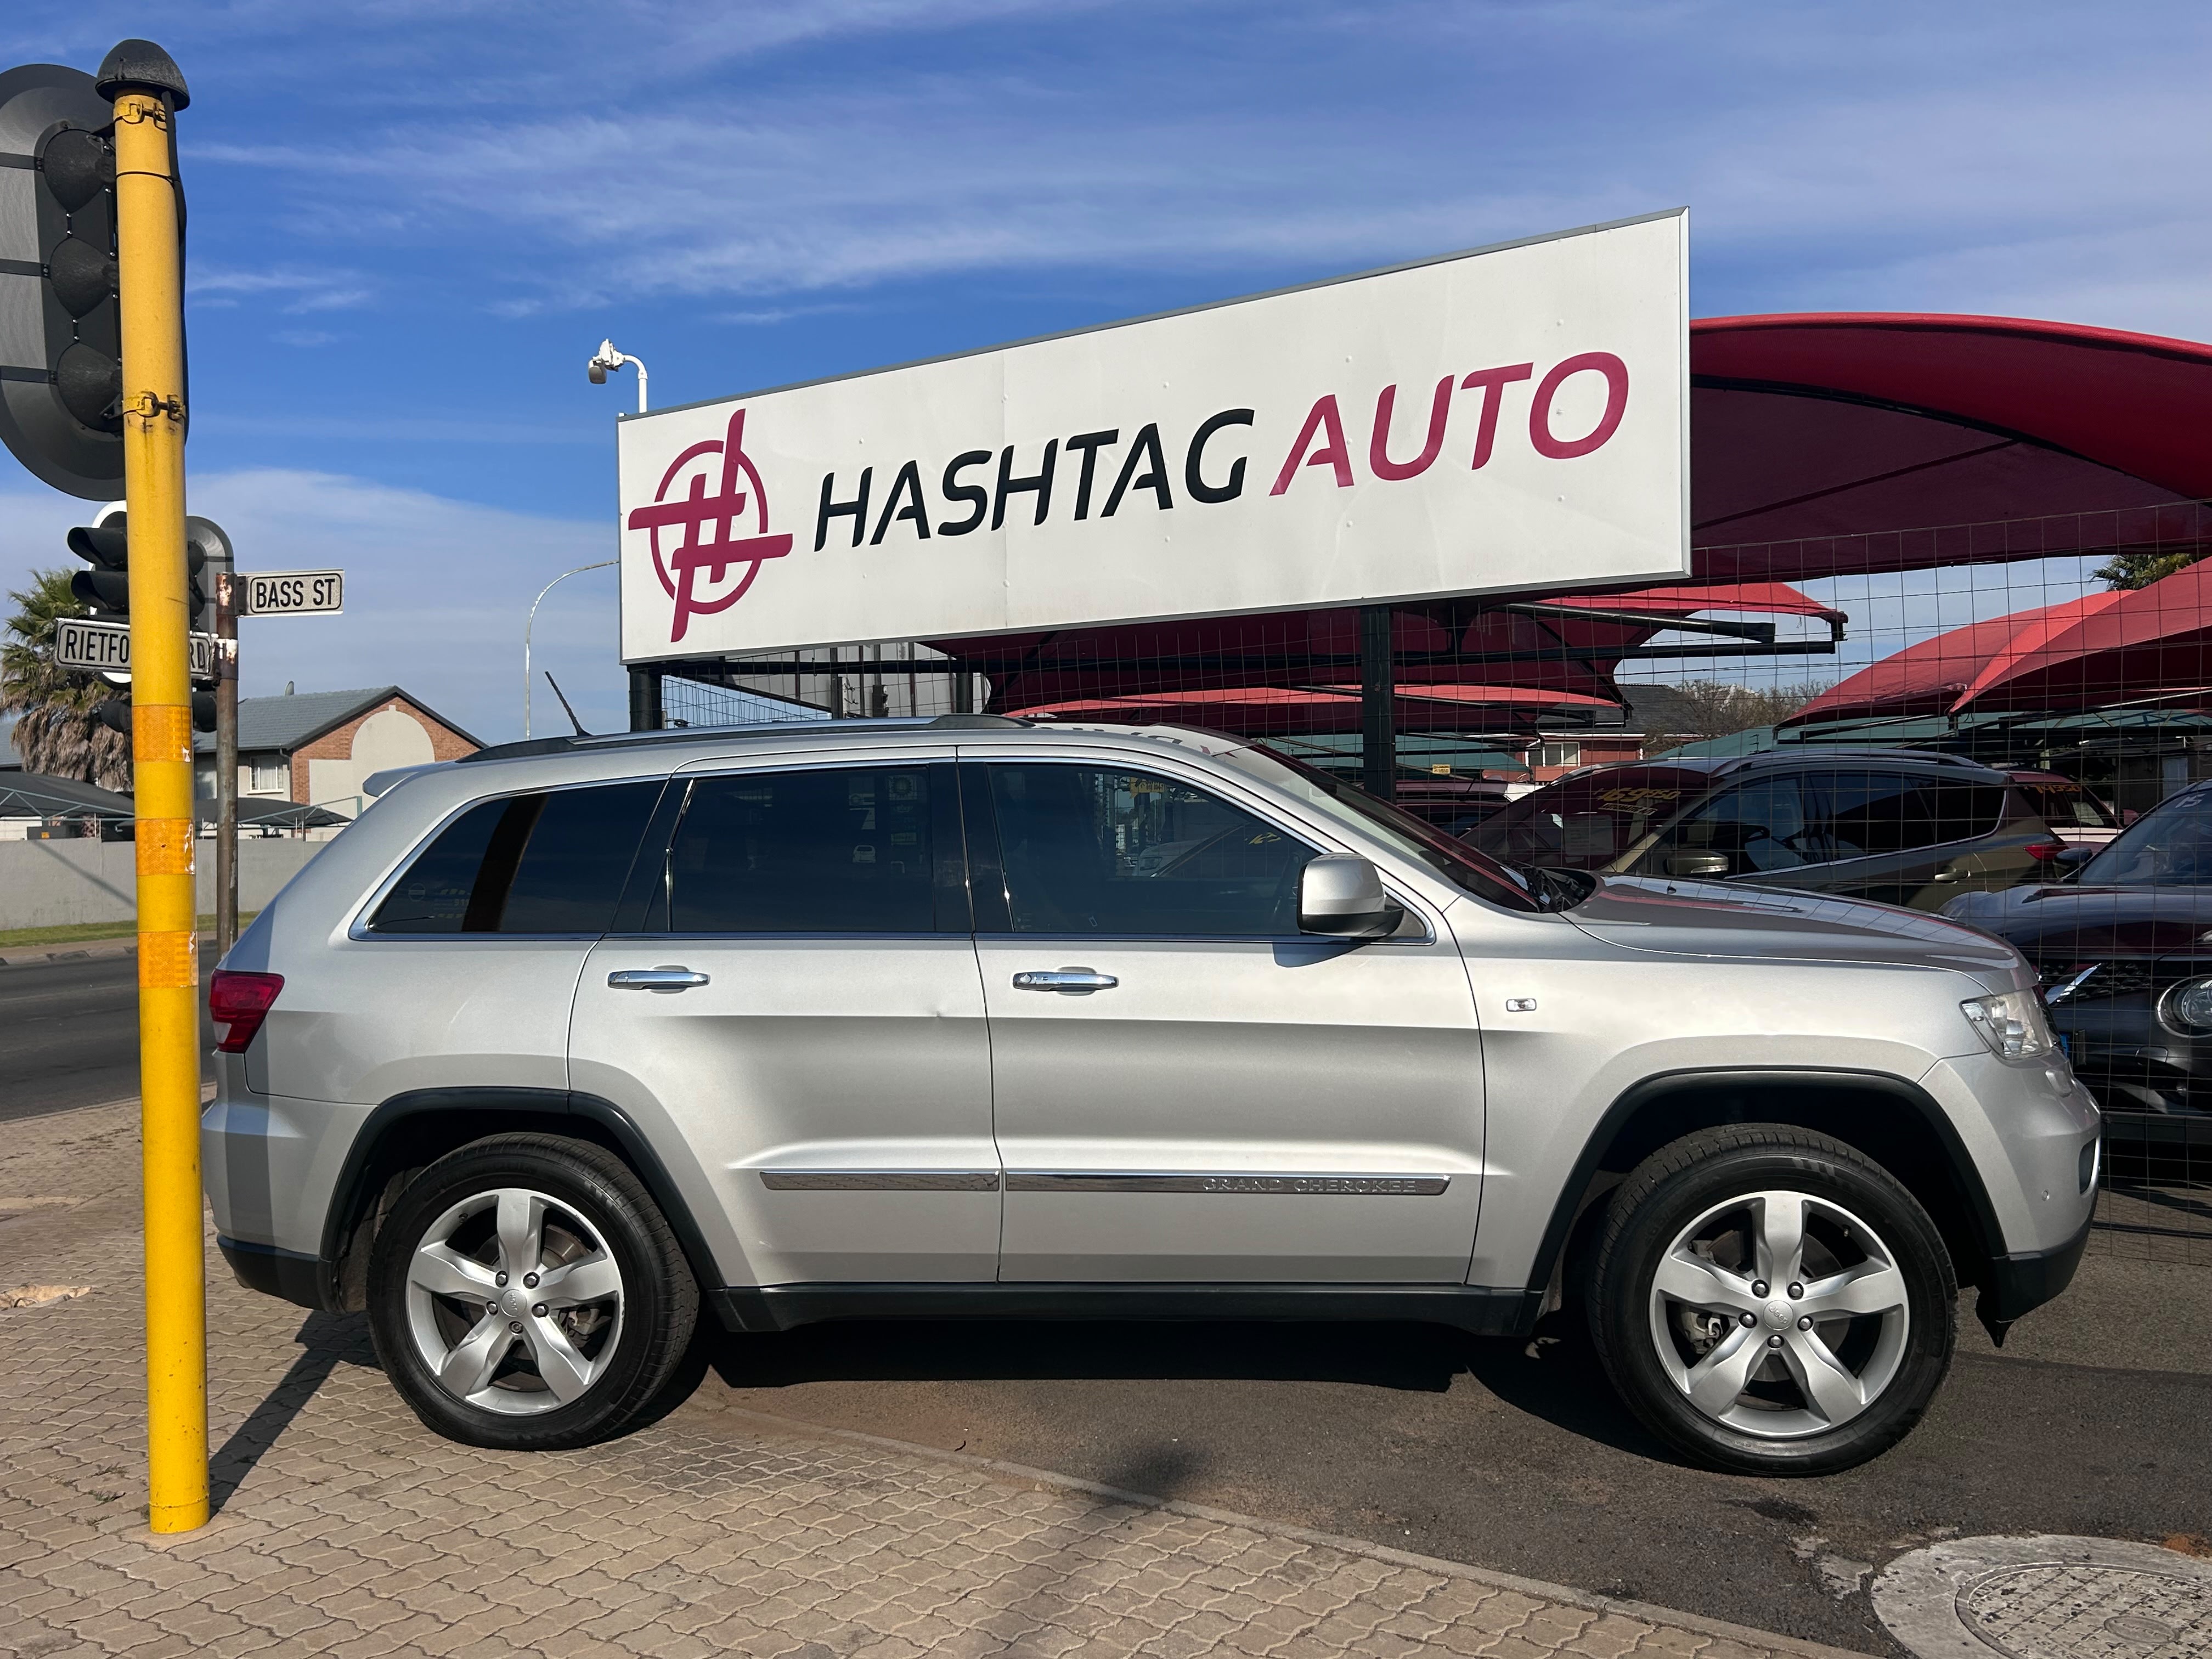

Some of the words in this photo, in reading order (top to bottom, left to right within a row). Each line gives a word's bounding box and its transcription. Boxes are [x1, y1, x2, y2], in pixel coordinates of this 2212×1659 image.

[814, 409, 1255, 552] HASHTAG
[1268, 352, 1629, 496] AUTO
[256, 580, 304, 608] BASS
[313, 578, 335, 606] ST
[65, 629, 131, 663] RIETFO
[1203, 1178, 1284, 1191] GRAND
[1294, 1179, 1417, 1193] CHEROKEE
